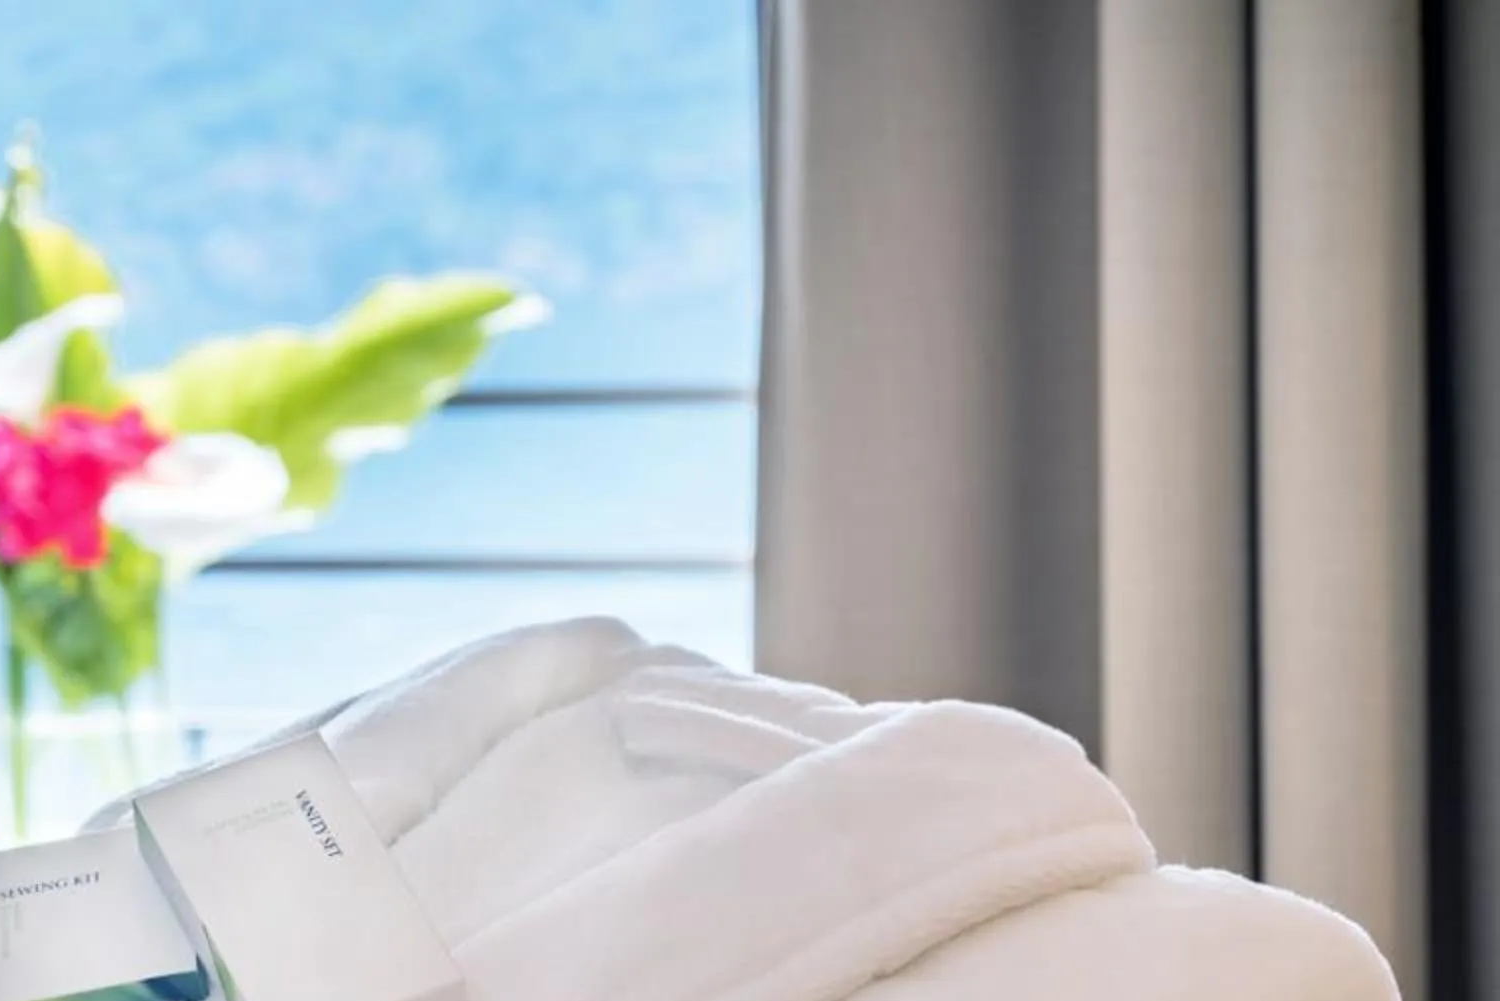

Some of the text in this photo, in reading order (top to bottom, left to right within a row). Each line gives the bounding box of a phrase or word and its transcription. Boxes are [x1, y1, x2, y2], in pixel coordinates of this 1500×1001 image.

[296, 789, 344, 857] VANITY SET
[0, 871, 100, 901] SEWING KIT
